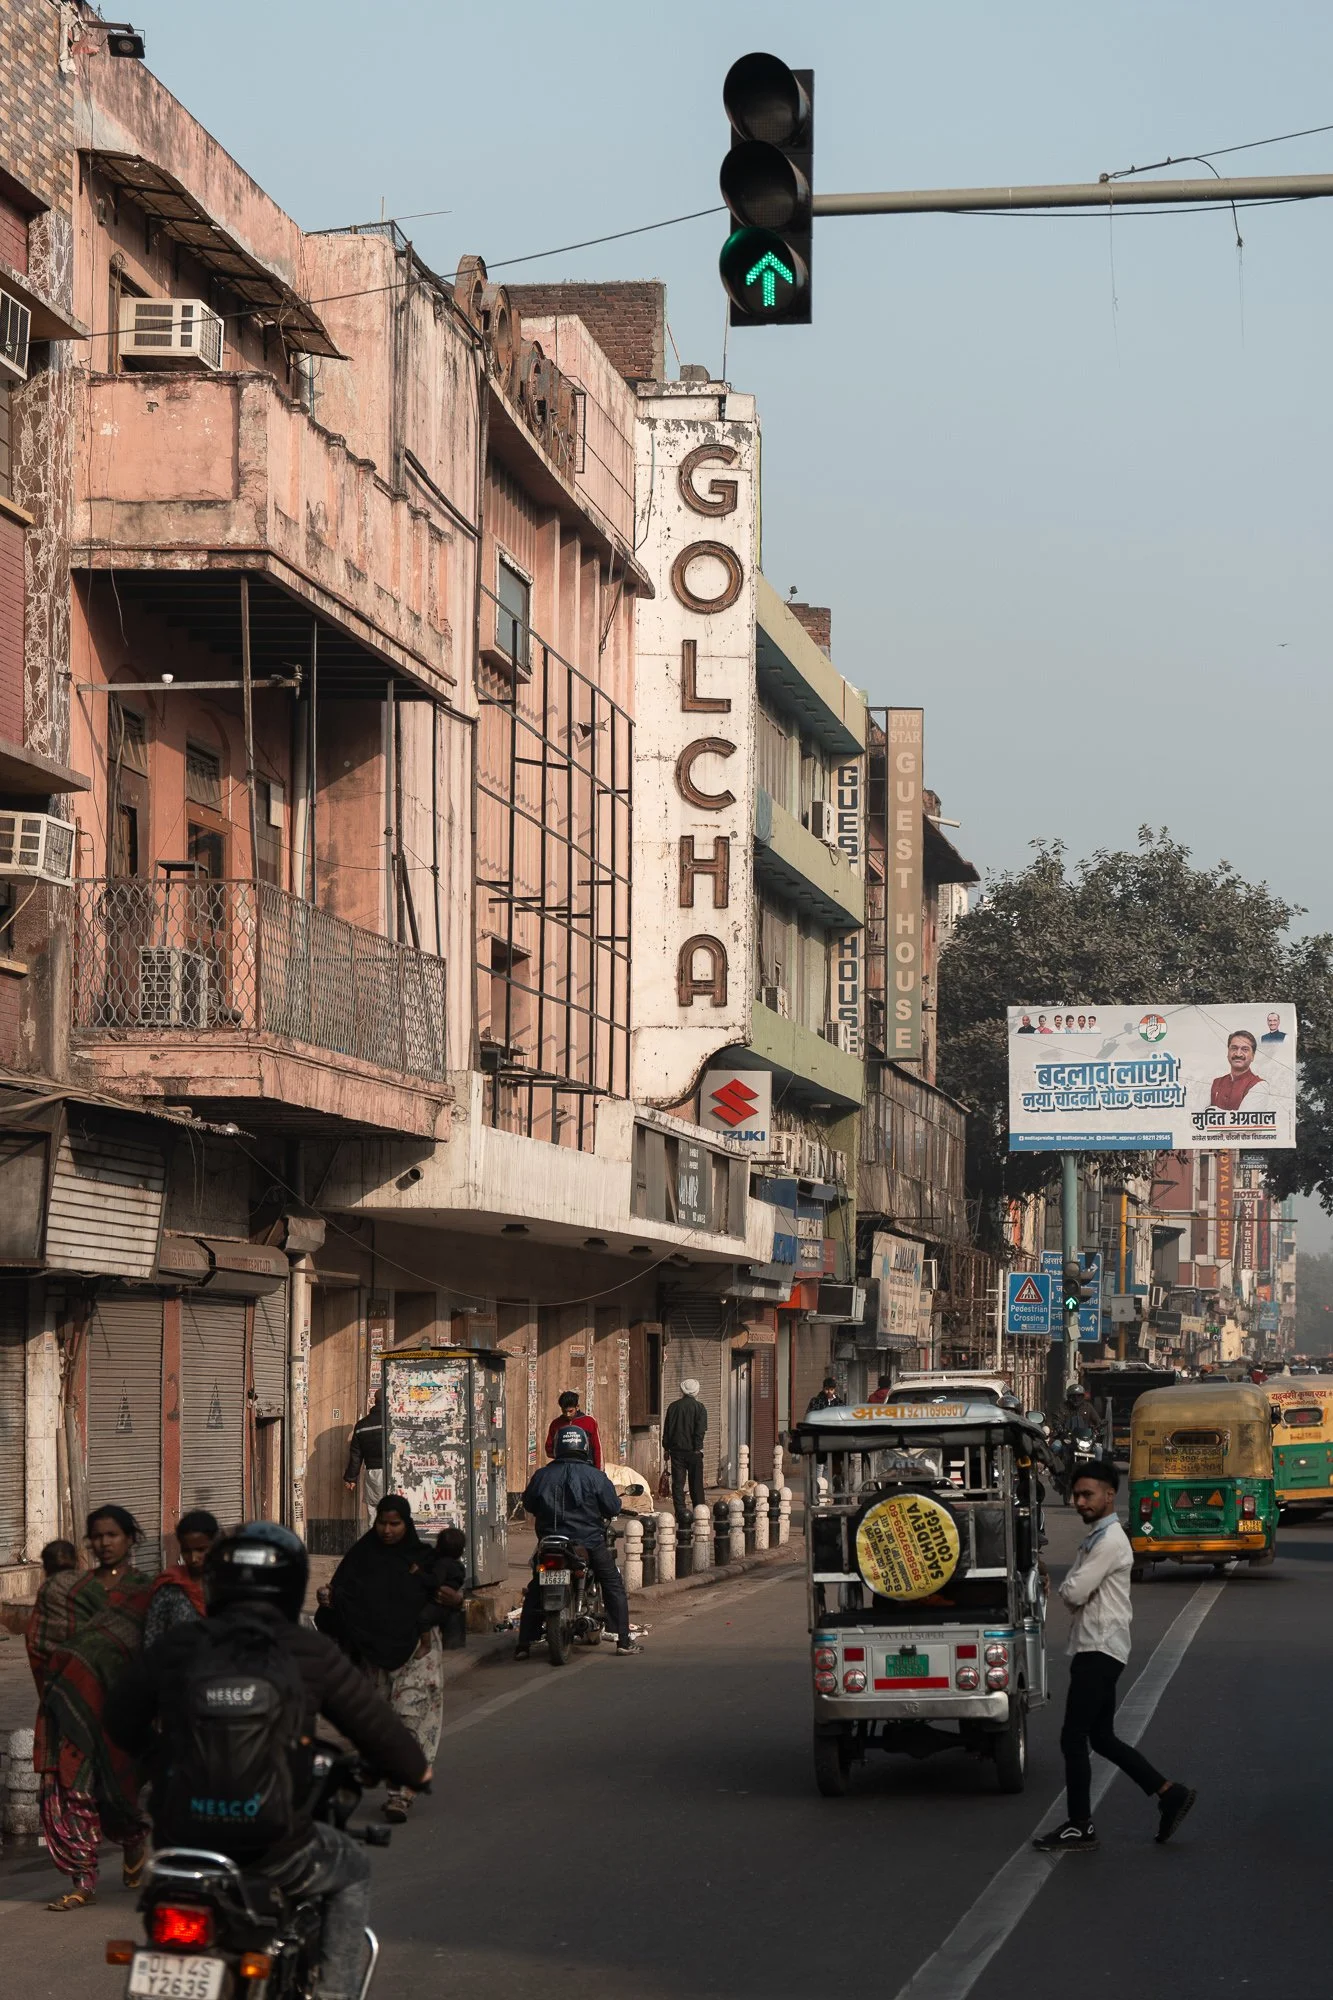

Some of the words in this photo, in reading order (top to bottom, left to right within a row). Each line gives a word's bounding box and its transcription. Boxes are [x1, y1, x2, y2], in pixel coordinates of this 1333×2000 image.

[671, 444, 743, 1007] GOLCHA
[891, 714, 919, 727] FIVE
[890, 731, 920, 743] STAR
[896, 752, 915, 888] GUEST
[895, 914, 915, 1048] HOUSE
[1036, 1062, 1111, 1087] बदलाव
[1114, 1052, 1176, 1084] लाएंगे
[1022, 1093, 1051, 1107] नया
[1101, 1086, 1130, 1105] चौक
[1191, 1108, 1226, 1130] मुदित
[1230, 1111, 1277, 1125] अग्रवाल
[1233, 1191, 1261, 1199] HOTEL
[1244, 1230, 1253, 1269] STREET
[1010, 1305, 1048, 1313] Pedestrian
[1013, 1314, 1044, 1323] Crossing
[852, 1407, 904, 1420] अम्बा
[871, 1520, 885, 1543] NDA
[906, 1502, 945, 1581] SACHDEVA
[924, 1508, 954, 1564] COLLEGE
[880, 1545, 903, 1592] Banking,
[880, 1571, 894, 1593] SSC
[206, 1687, 254, 1701] NESCO
[191, 1797, 259, 1817] NESCO
